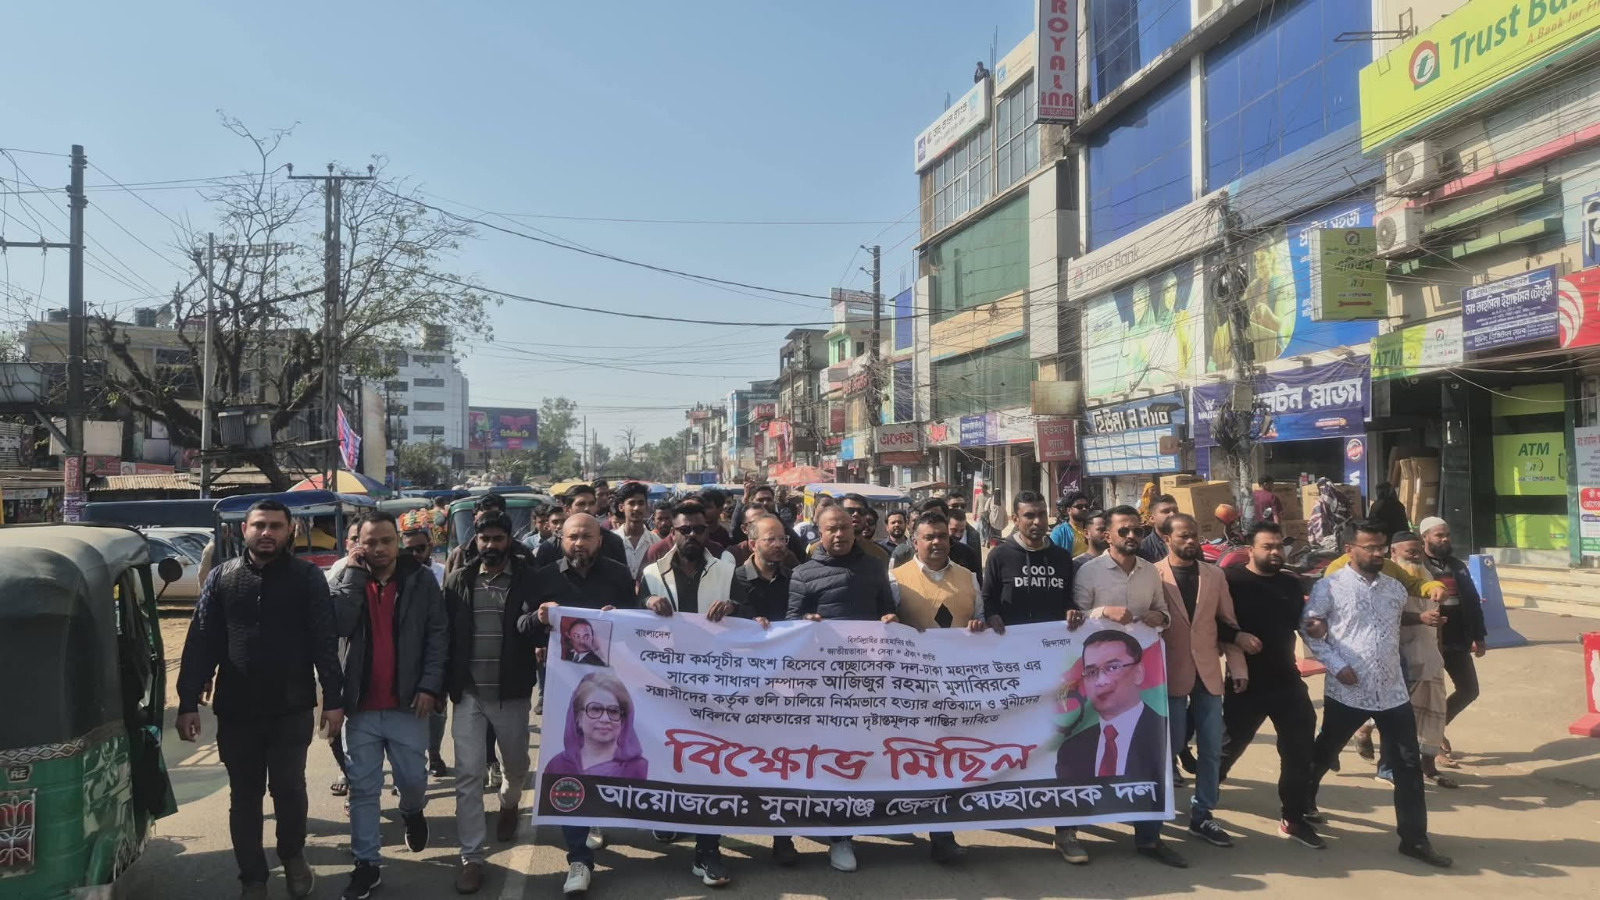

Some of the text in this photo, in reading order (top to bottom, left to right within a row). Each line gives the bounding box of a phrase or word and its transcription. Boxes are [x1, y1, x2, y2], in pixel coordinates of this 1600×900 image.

[1450, 4, 1520, 70] Trust
[1537, 18, 1563, 39] Bank
[1047, 0, 1069, 90] ROYAL
[1086, 244, 1140, 280] Prime Bank
[1308, 377, 1364, 409] প্লাজা
[1518, 442, 1550, 456] ATM
[634, 628, 671, 640] বাংলাদেশ
[640, 647, 1042, 676] কেন্দ্রীয় কর্মসূচীর অংশ হিসেবে স্বেচ্ছাসেবক দল-ঢাকা মহানগর উত্তর এর
[667, 670, 1020, 697] সাবেক সাধারণ সম্পাদক আজিজুর রহমান মুসাব্বিরকে
[712, 691, 750, 711] কর্তৃক
[754, 691, 779, 707] গুলি
[783, 692, 825, 708] চালিয়ে
[829, 693, 887, 709] নির্মমভাবে
[890, 696, 927, 710] হত্যার
[932, 696, 982, 711] প্রতিবাদে
[987, 699, 996, 710] ও
[689, 706, 1000, 731] অবিলম্বে গ্রেফতারের মাধ্যমে দৃষ্টান্তমূলক শাস্তির দাবিতে
[664, 728, 1037, 782] বিক্ষোভ মিছিল
[596, 783, 749, 817] আয়োজনে:
[759, 794, 875, 823] সুনামগঞ্জ
[885, 793, 950, 816] জেলা
[958, 784, 1103, 814] স্বেচ্ছাসেবক
[1109, 780, 1159, 803] দল
